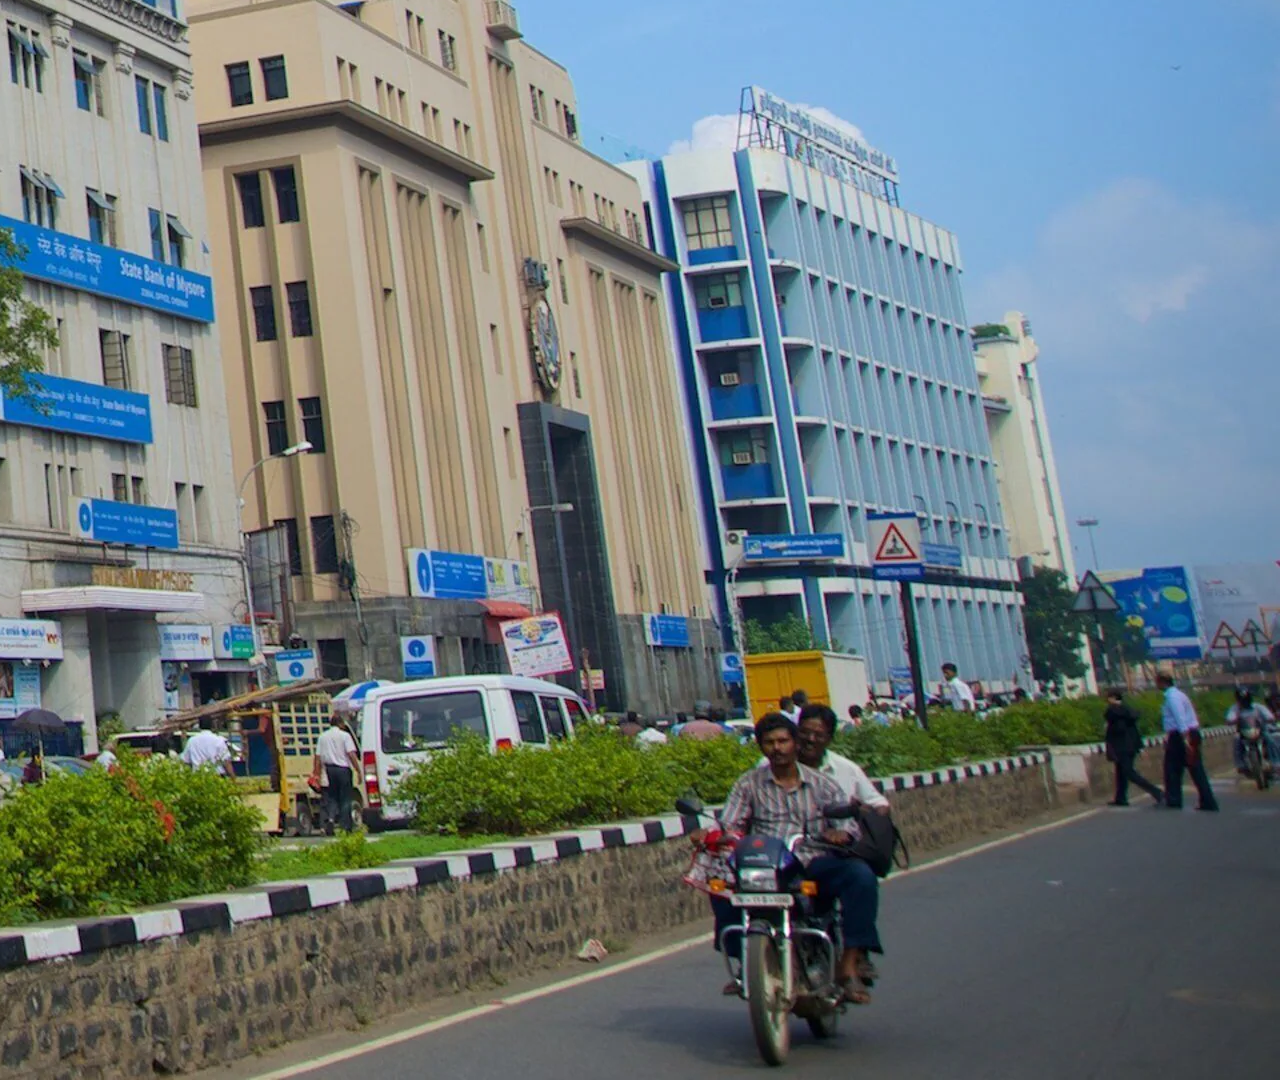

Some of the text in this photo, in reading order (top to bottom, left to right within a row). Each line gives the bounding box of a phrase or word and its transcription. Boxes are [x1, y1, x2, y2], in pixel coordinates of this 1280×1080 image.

[120, 257, 143, 281] State
[144, 264, 166, 287] Bank
[166, 272, 175, 289] of
[176, 274, 206, 299] Mysore
